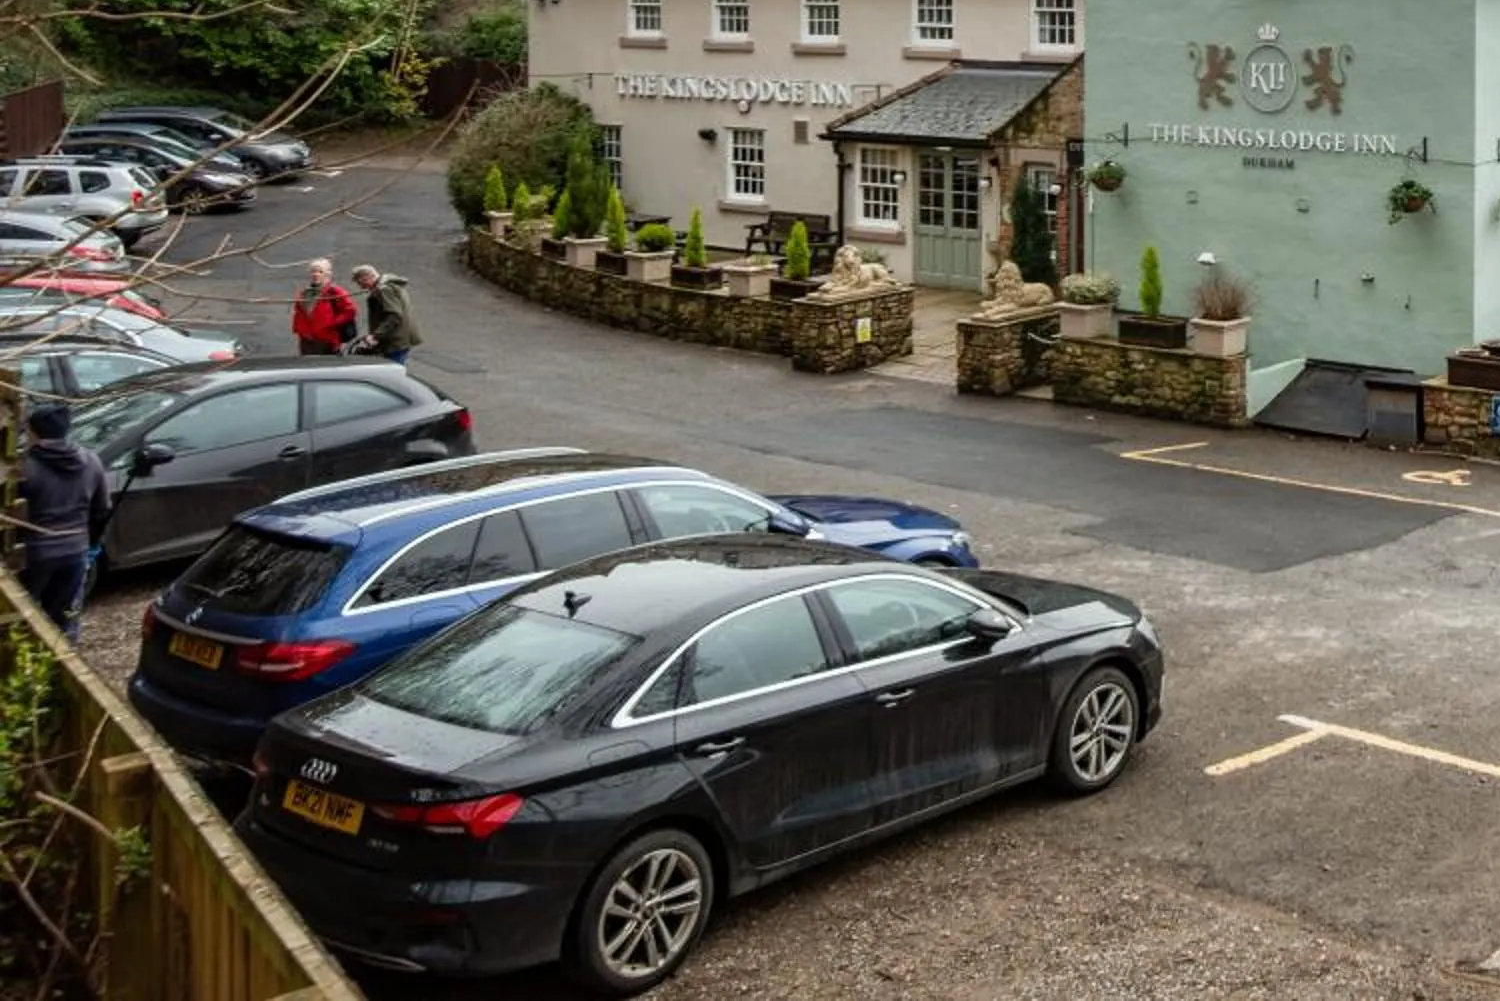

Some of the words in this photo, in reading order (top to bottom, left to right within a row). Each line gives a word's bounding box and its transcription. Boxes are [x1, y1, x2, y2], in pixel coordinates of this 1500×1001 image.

[614, 74, 657, 98] THE
[661, 77, 804, 103] KINGSLODGE
[810, 83, 852, 106] INN
[1149, 123, 1193, 143] THE
[1198, 127, 1345, 152] KINGSLODGE
[1353, 133, 1397, 155] INN
